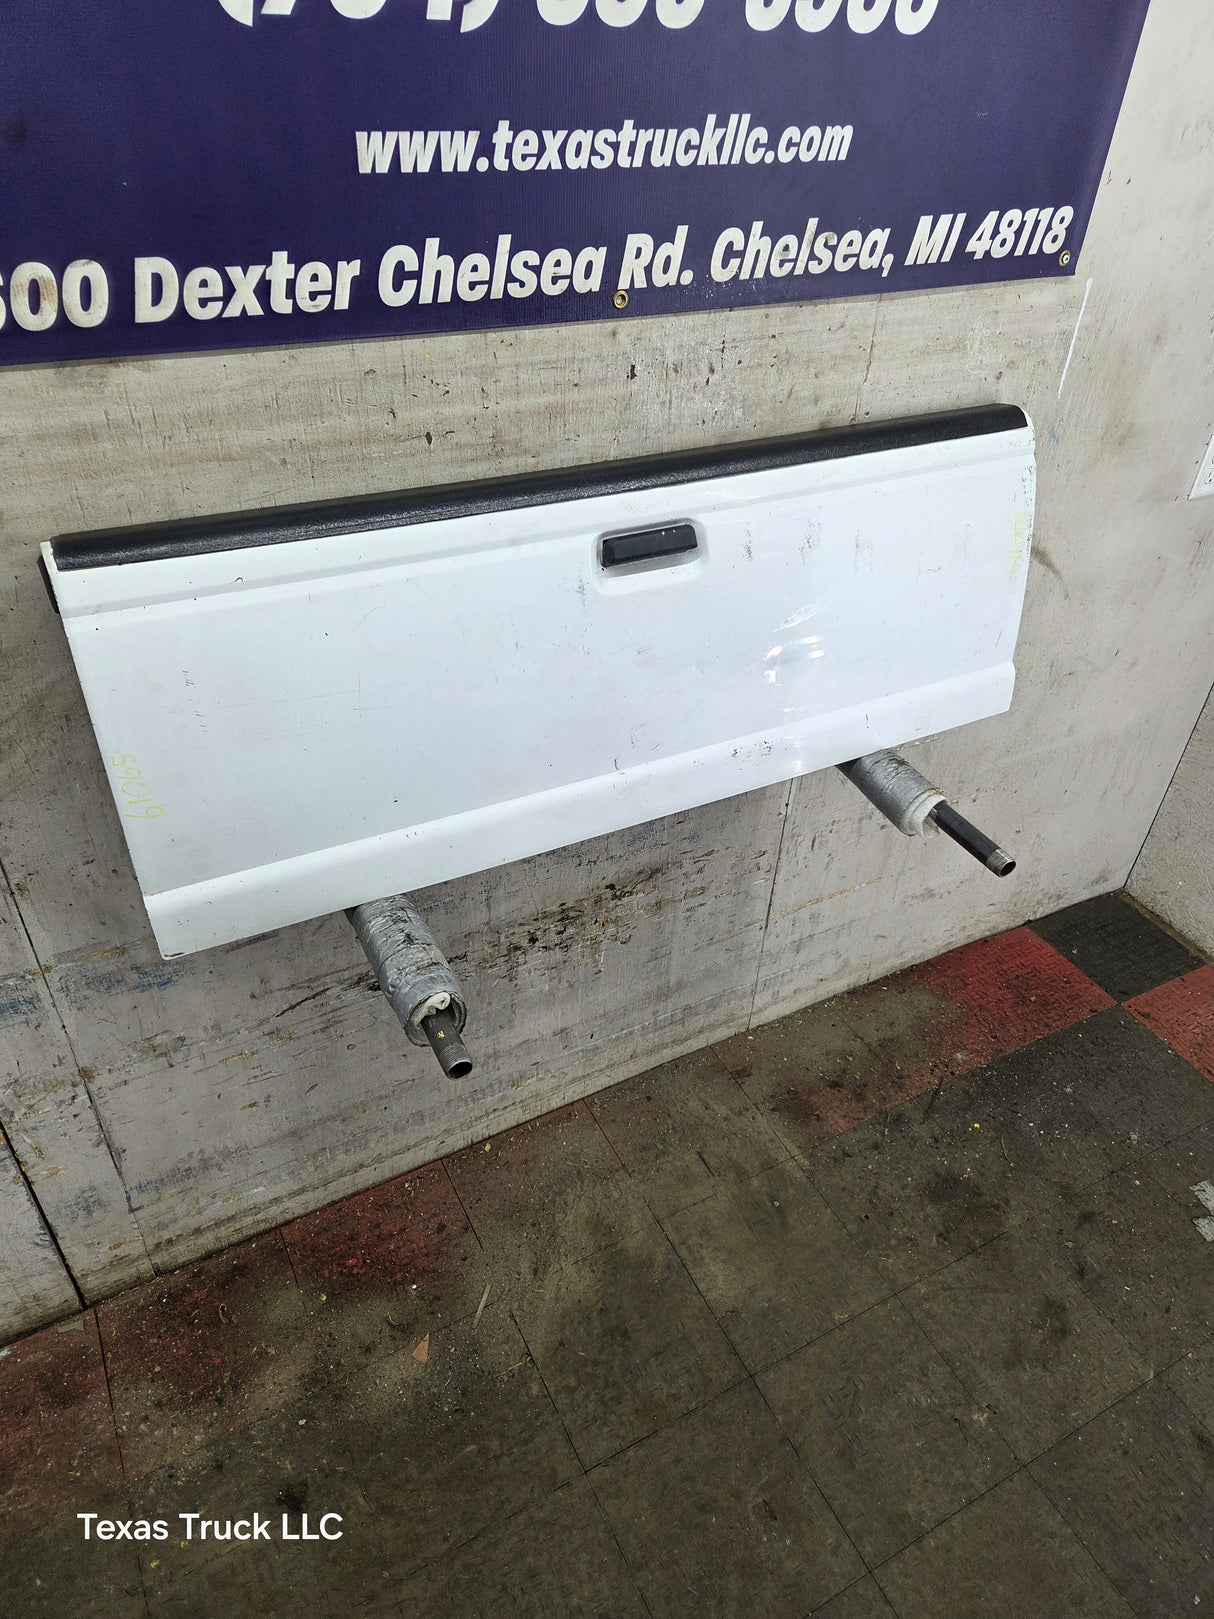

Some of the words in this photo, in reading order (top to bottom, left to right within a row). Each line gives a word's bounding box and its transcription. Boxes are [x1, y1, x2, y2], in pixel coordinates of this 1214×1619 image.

[355, 113, 854, 174] www.texastruckllc.com
[0, 259, 109, 332] 00
[134, 250, 361, 324] Dexter
[378, 233, 608, 307] Chelsea
[617, 224, 694, 291] Rd.
[710, 217, 895, 283] Chelsea,
[903, 212, 967, 266] MI
[964, 205, 1075, 260] 48118
